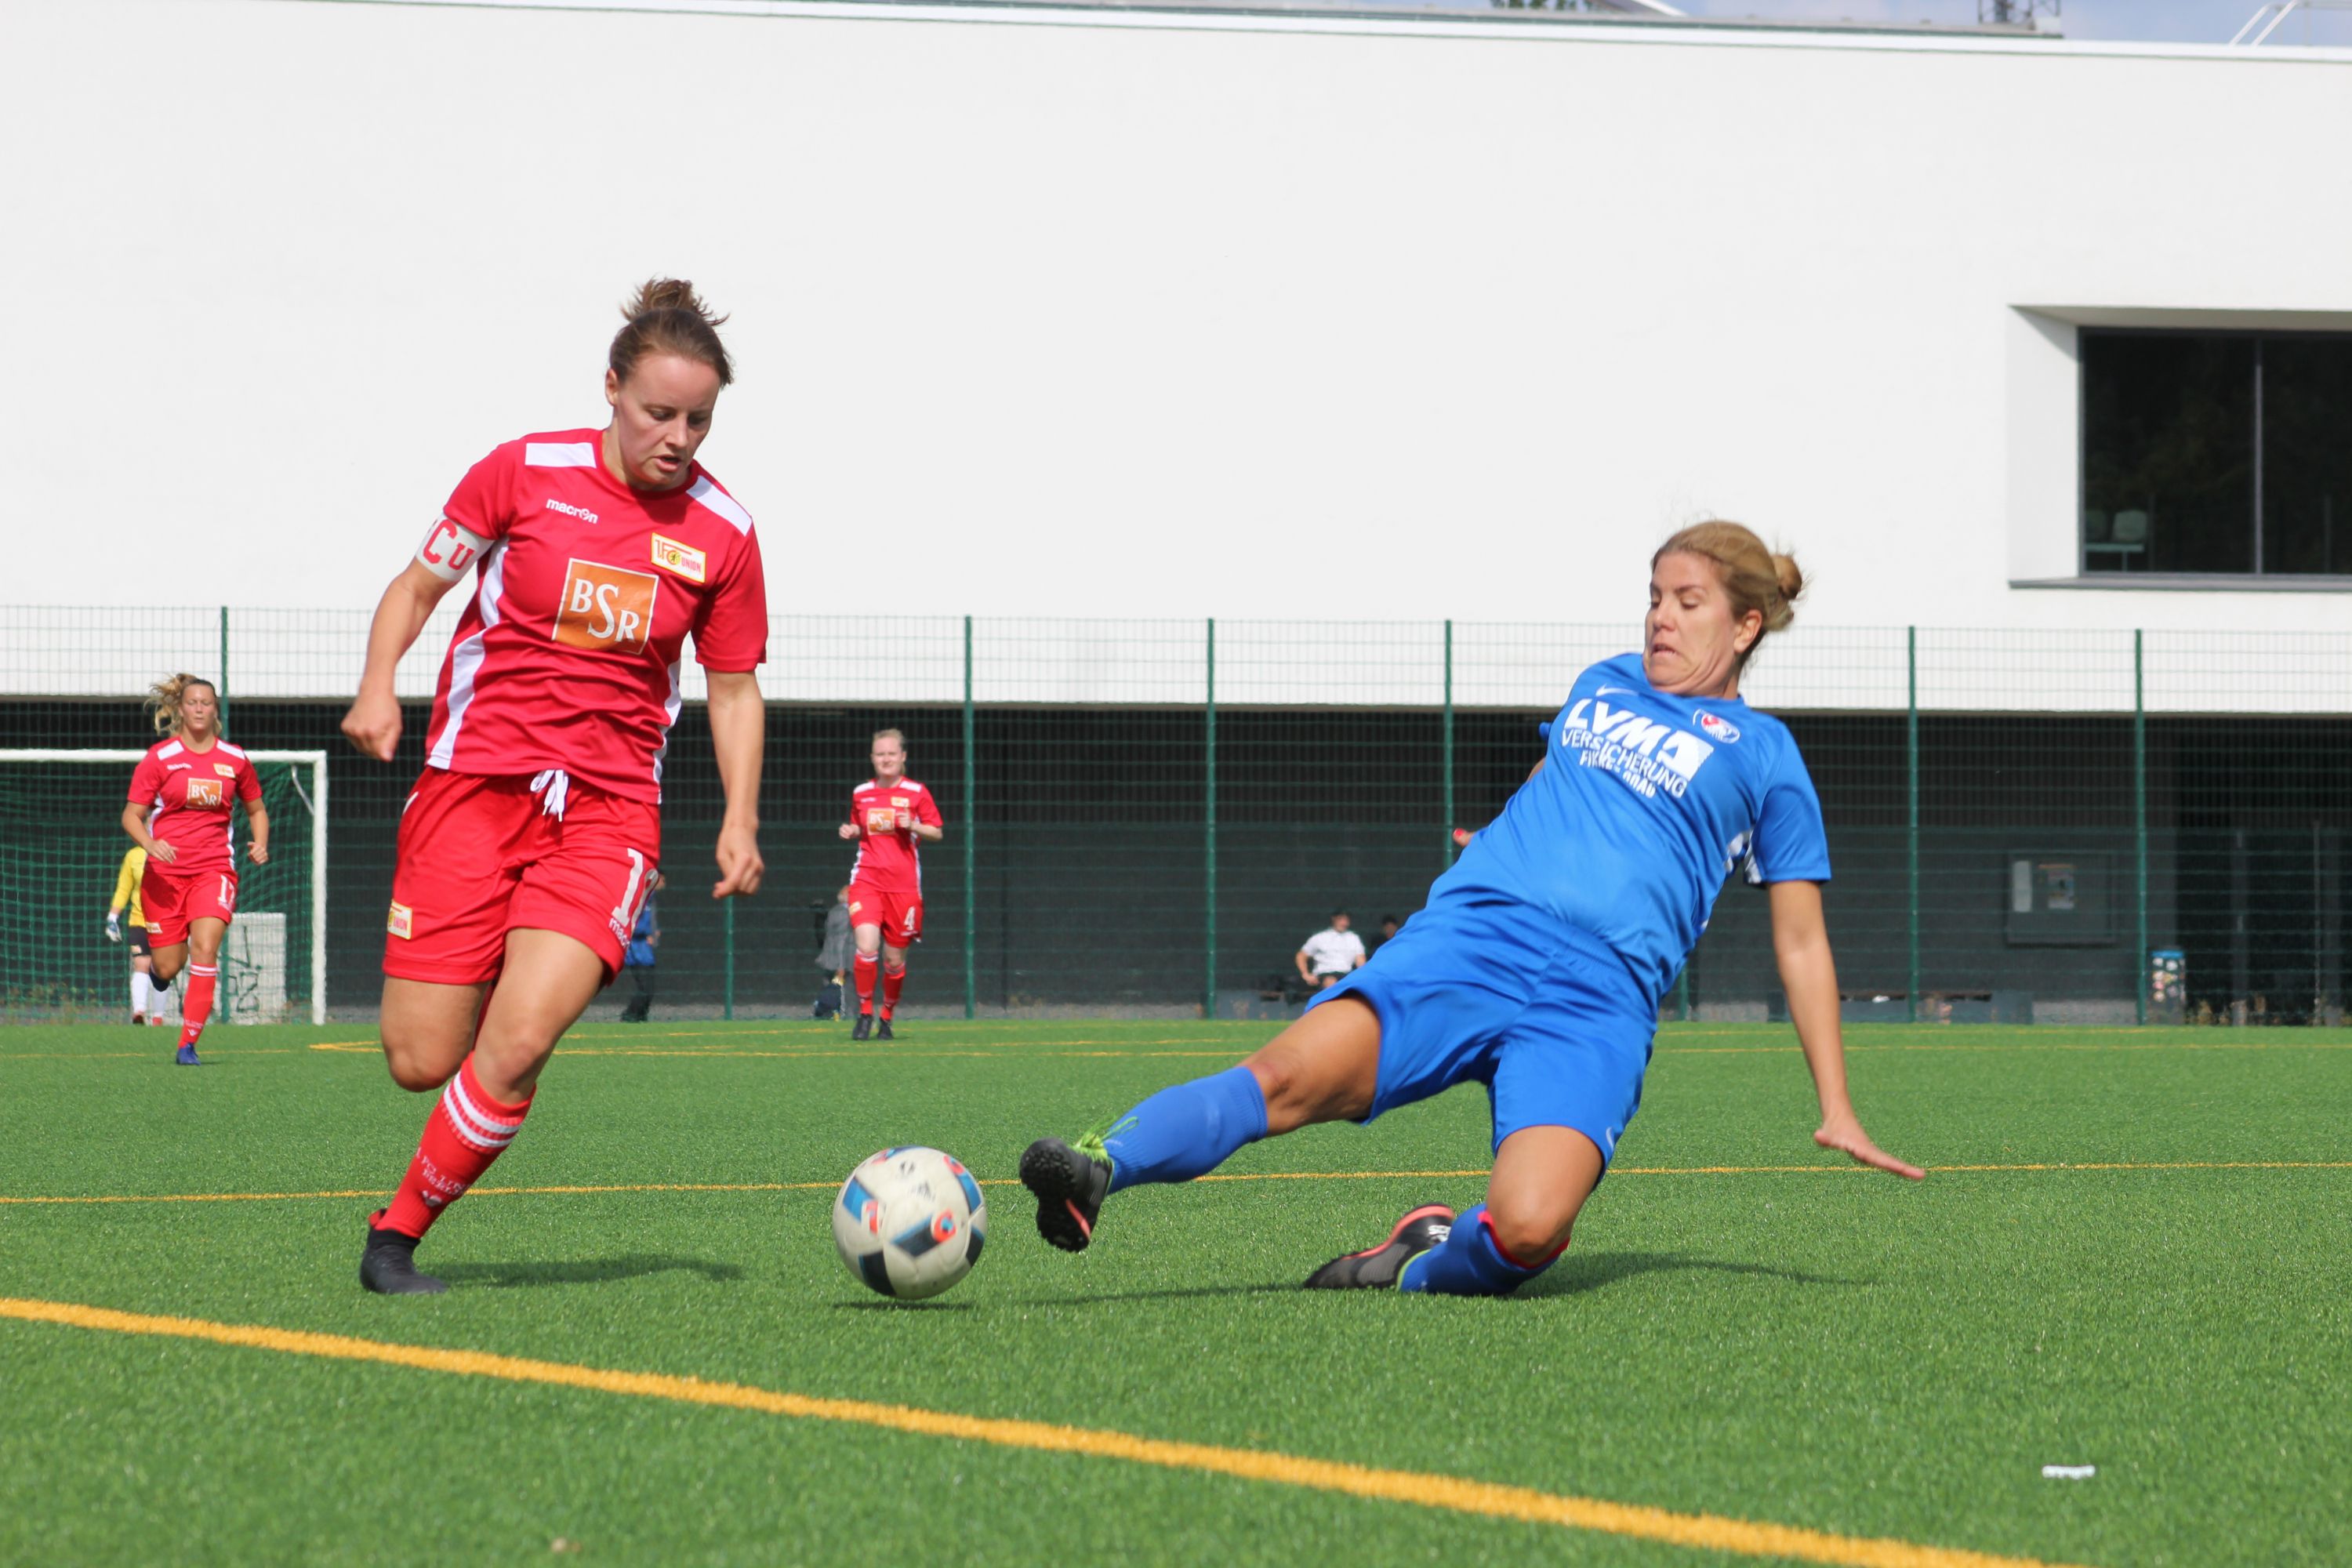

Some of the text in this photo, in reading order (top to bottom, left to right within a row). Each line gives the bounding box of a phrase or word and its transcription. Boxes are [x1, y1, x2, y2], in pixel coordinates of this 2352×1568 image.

[546, 498, 598, 524] macron
[681, 557, 702, 573] UNION
[568, 578, 641, 643] BSR
[1562, 728, 1689, 799] VERSICHERUNG
[191, 785, 218, 806] BSR
[904, 906, 916, 931] 4
